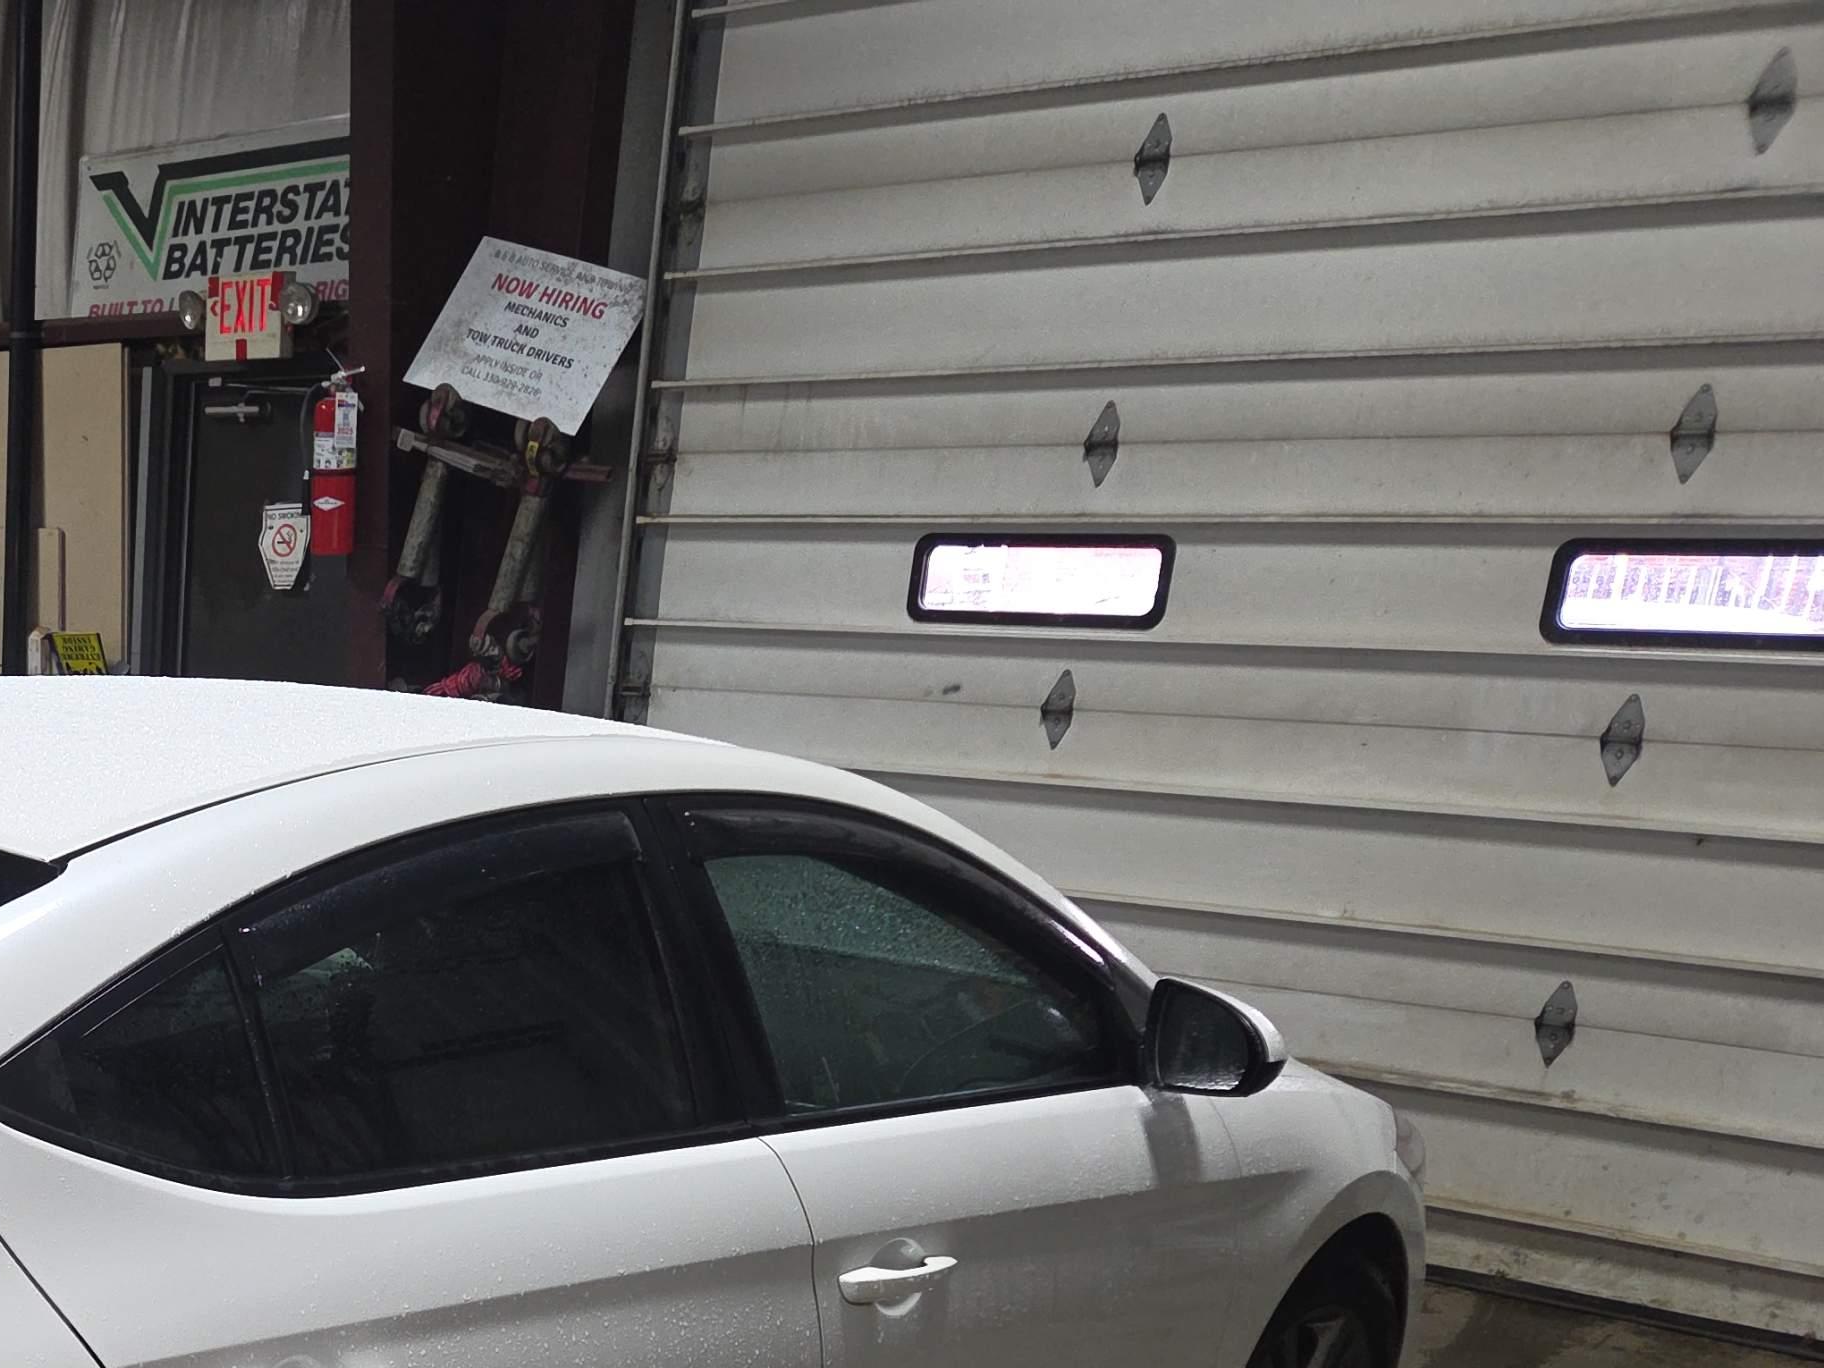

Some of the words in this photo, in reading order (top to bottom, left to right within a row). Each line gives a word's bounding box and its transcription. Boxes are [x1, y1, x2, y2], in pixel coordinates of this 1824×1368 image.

[220, 279, 271, 334] EXIT
[491, 273, 538, 299] NOW
[539, 286, 608, 320] HIRING
[504, 301, 570, 328] MECHANICS
[514, 324, 539, 339] AND
[467, 328, 491, 345] TOW
[491, 335, 526, 356] TRUCK
[526, 346, 574, 369] DRIVERS
[461, 366, 481, 380] CALL
[475, 354, 499, 371] APPLY
[500, 359, 527, 378] INSIDE
[529, 368, 543, 381] OR
